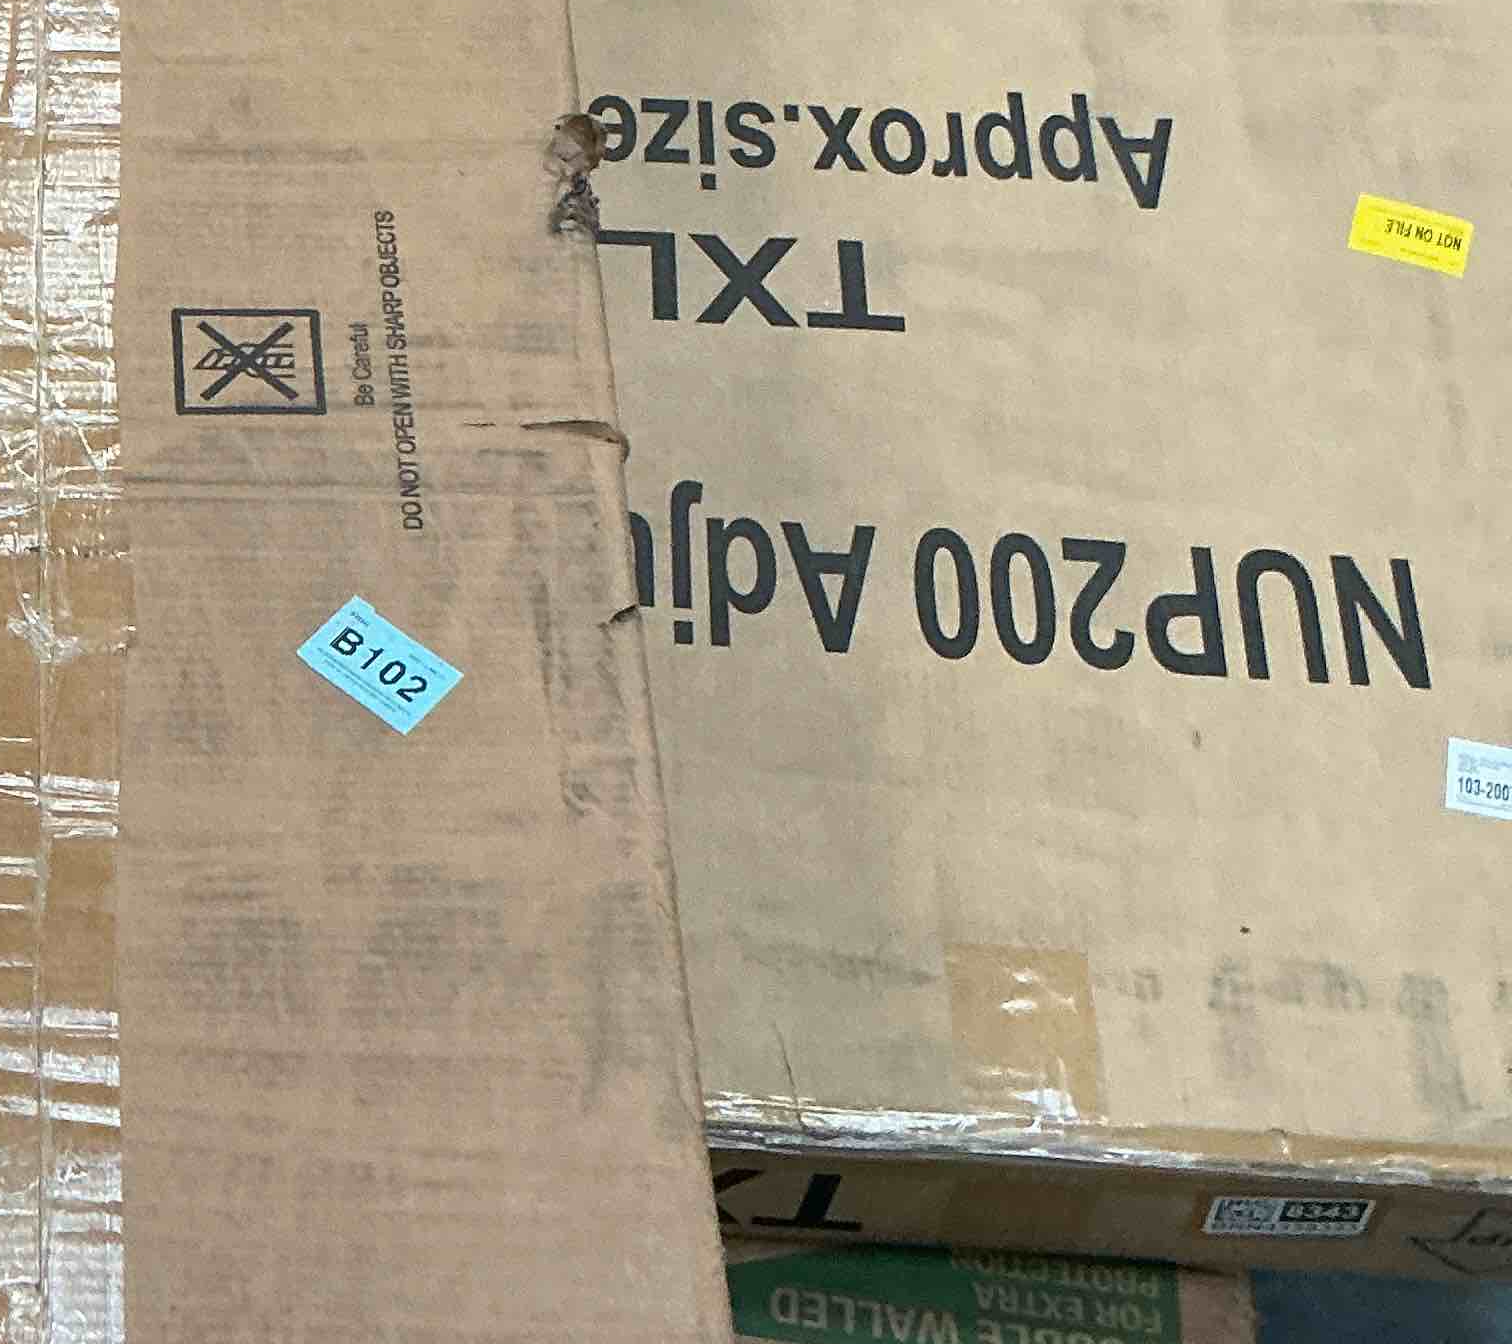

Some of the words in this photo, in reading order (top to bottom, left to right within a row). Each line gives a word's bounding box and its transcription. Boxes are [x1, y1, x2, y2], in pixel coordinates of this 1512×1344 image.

[587, 92, 1173, 211] Approx.size
[374, 209, 401, 290] OBJECTS
[1383, 219, 1413, 238] FILE
[1414, 225, 1434, 243] ON
[1436, 233, 1463, 252] NOT
[596, 229, 907, 332] TXL
[382, 291, 407, 351] SHARP
[348, 319, 372, 381] Careful
[353, 383, 375, 408] Be
[389, 353, 411, 403] WITH
[393, 401, 417, 455] OPEN
[398, 456, 422, 499] NOT
[403, 500, 424, 531] DO
[912, 526, 1433, 690] NUP200
[329, 625, 428, 704] B102
[972, 1282, 1083, 1322] EXTRA
[1090, 1300, 1161, 1337] FOR
